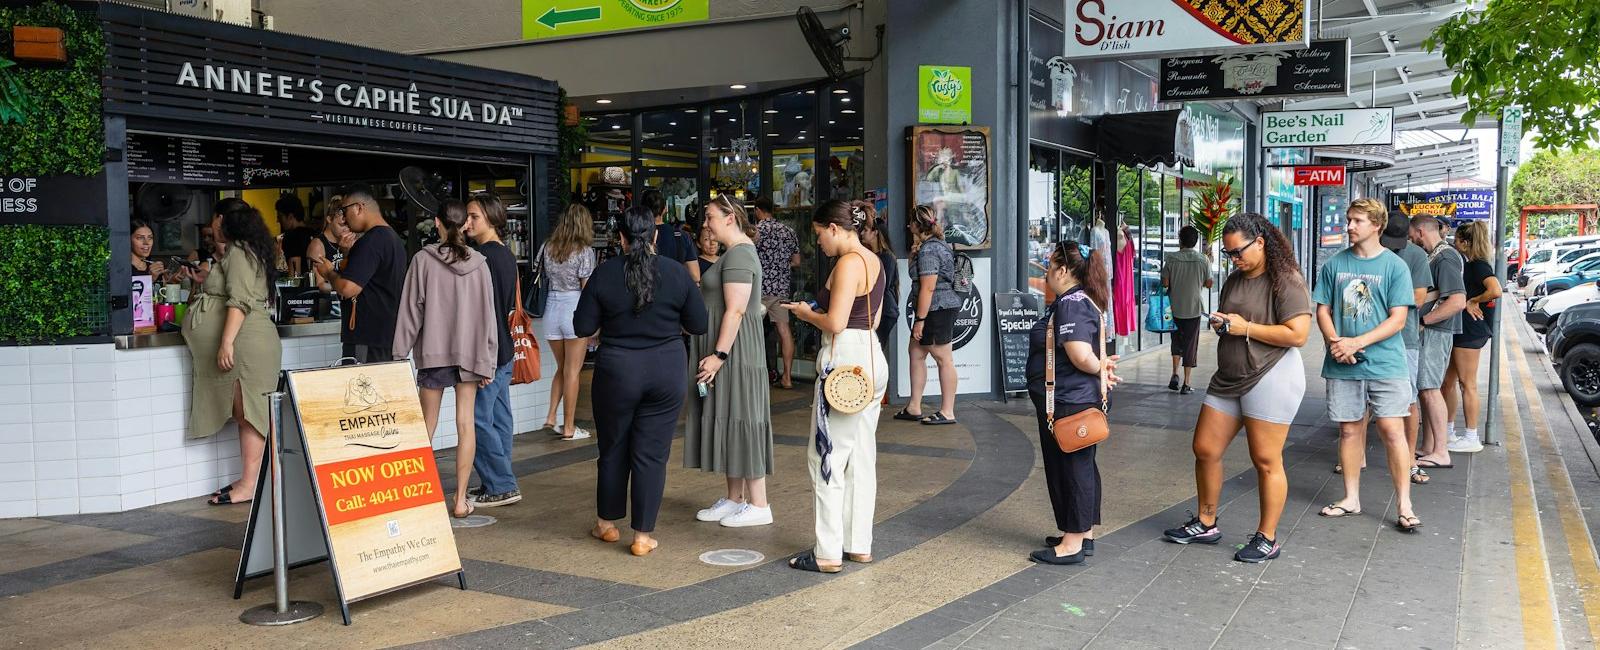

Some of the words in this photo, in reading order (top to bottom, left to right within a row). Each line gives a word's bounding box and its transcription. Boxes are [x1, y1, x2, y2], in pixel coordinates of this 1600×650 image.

[646, 13, 665, 22] SINCE
[1075, 0, 1165, 46] Siam
[1100, 41, 1130, 51] D'lish
[1166, 70, 1208, 81] Romantic
[1293, 64, 1330, 77] Lingerie
[176, 61, 324, 103] ANNEE'S
[334, 82, 421, 115] CAPHÊ
[429, 96, 474, 121] SUA
[1166, 86, 1210, 97] Irresistible
[1293, 80, 1342, 91] Accessories
[325, 114, 386, 128] VIETNAMESE
[389, 121, 422, 132] COFFEE
[1267, 115, 1307, 128] Bee's
[1311, 113, 1344, 126] Nail
[1505, 109, 1521, 123] 2P
[1266, 131, 1326, 143] Garden
[1309, 170, 1341, 181] ATM
[8, 177, 37, 192] OF
[0, 197, 38, 213] ESS
[1429, 193, 1469, 203] CRYSTAL
[1471, 193, 1493, 203] BALL
[954, 318, 979, 326] SSERIE
[339, 412, 397, 432] EMPATHY
[331, 465, 376, 489] NOW
[380, 457, 425, 479] OPEN
[335, 494, 367, 512] Call:
[369, 488, 401, 505] 4041
[402, 481, 433, 498] 0272
[357, 550, 373, 563] The
[374, 543, 407, 560] Empathy
[406, 540, 420, 550] We
[420, 536, 437, 547] Care
